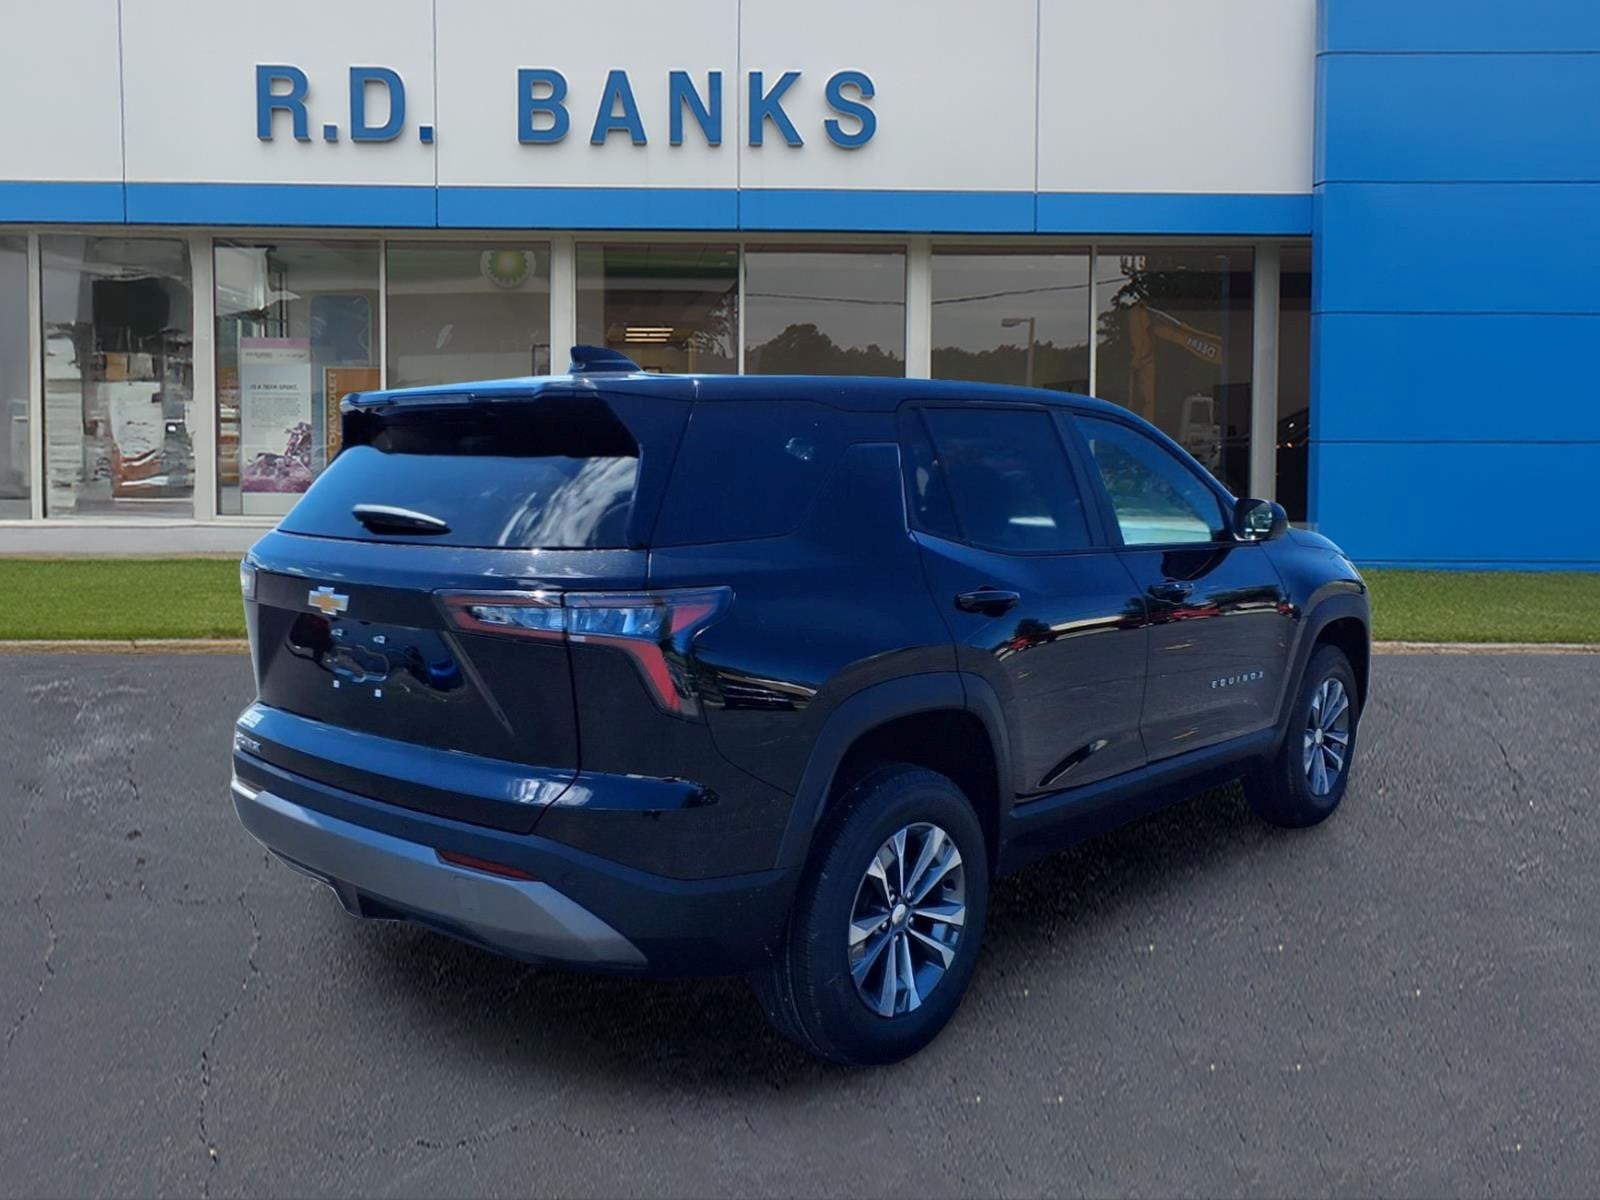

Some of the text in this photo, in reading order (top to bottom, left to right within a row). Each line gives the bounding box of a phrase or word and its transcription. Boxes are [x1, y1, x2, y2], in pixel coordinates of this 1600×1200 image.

[256, 64, 878, 148] R.D. BANKS
[1211, 671, 1264, 689] EQUINOX
